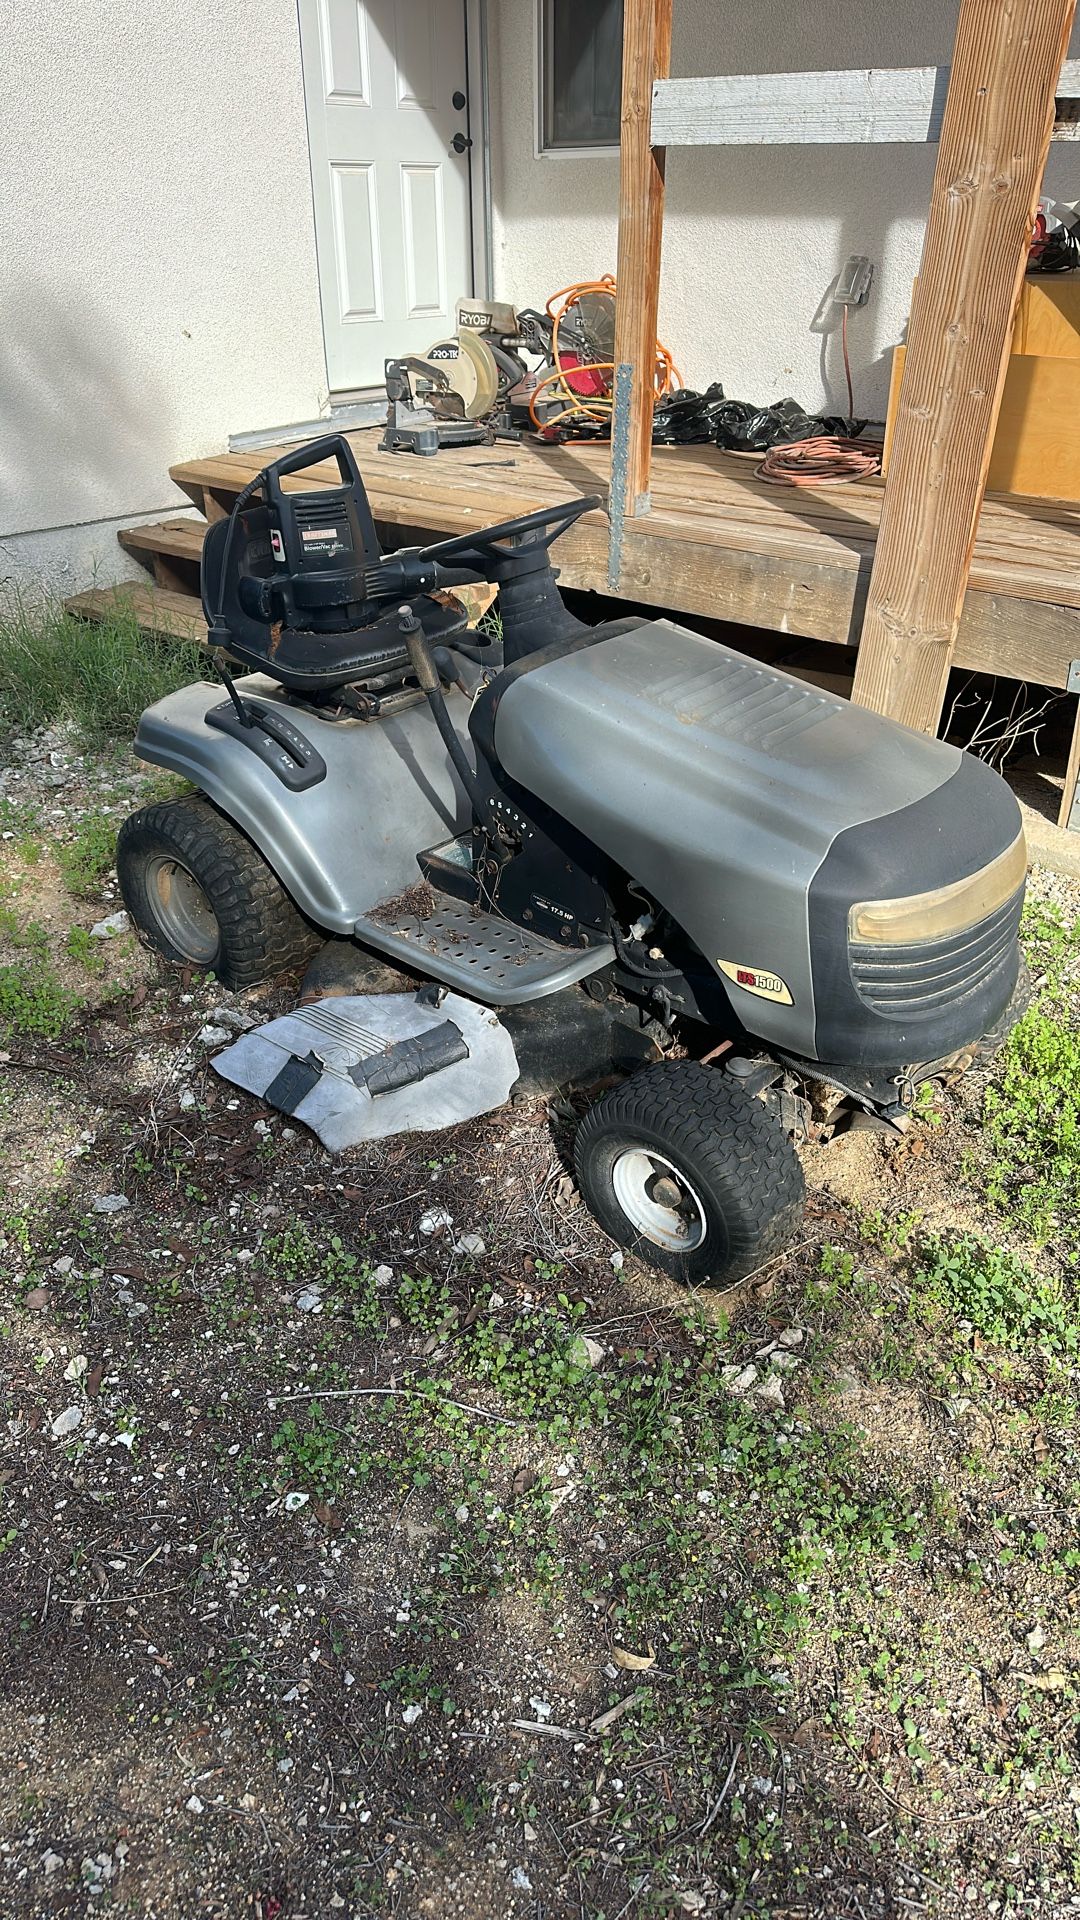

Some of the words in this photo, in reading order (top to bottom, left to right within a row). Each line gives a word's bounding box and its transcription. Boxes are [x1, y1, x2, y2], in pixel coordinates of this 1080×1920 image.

[460, 312, 491, 325] RYOBI
[563, 912, 574, 921] HP
[737, 970, 782, 993] LTS1500
